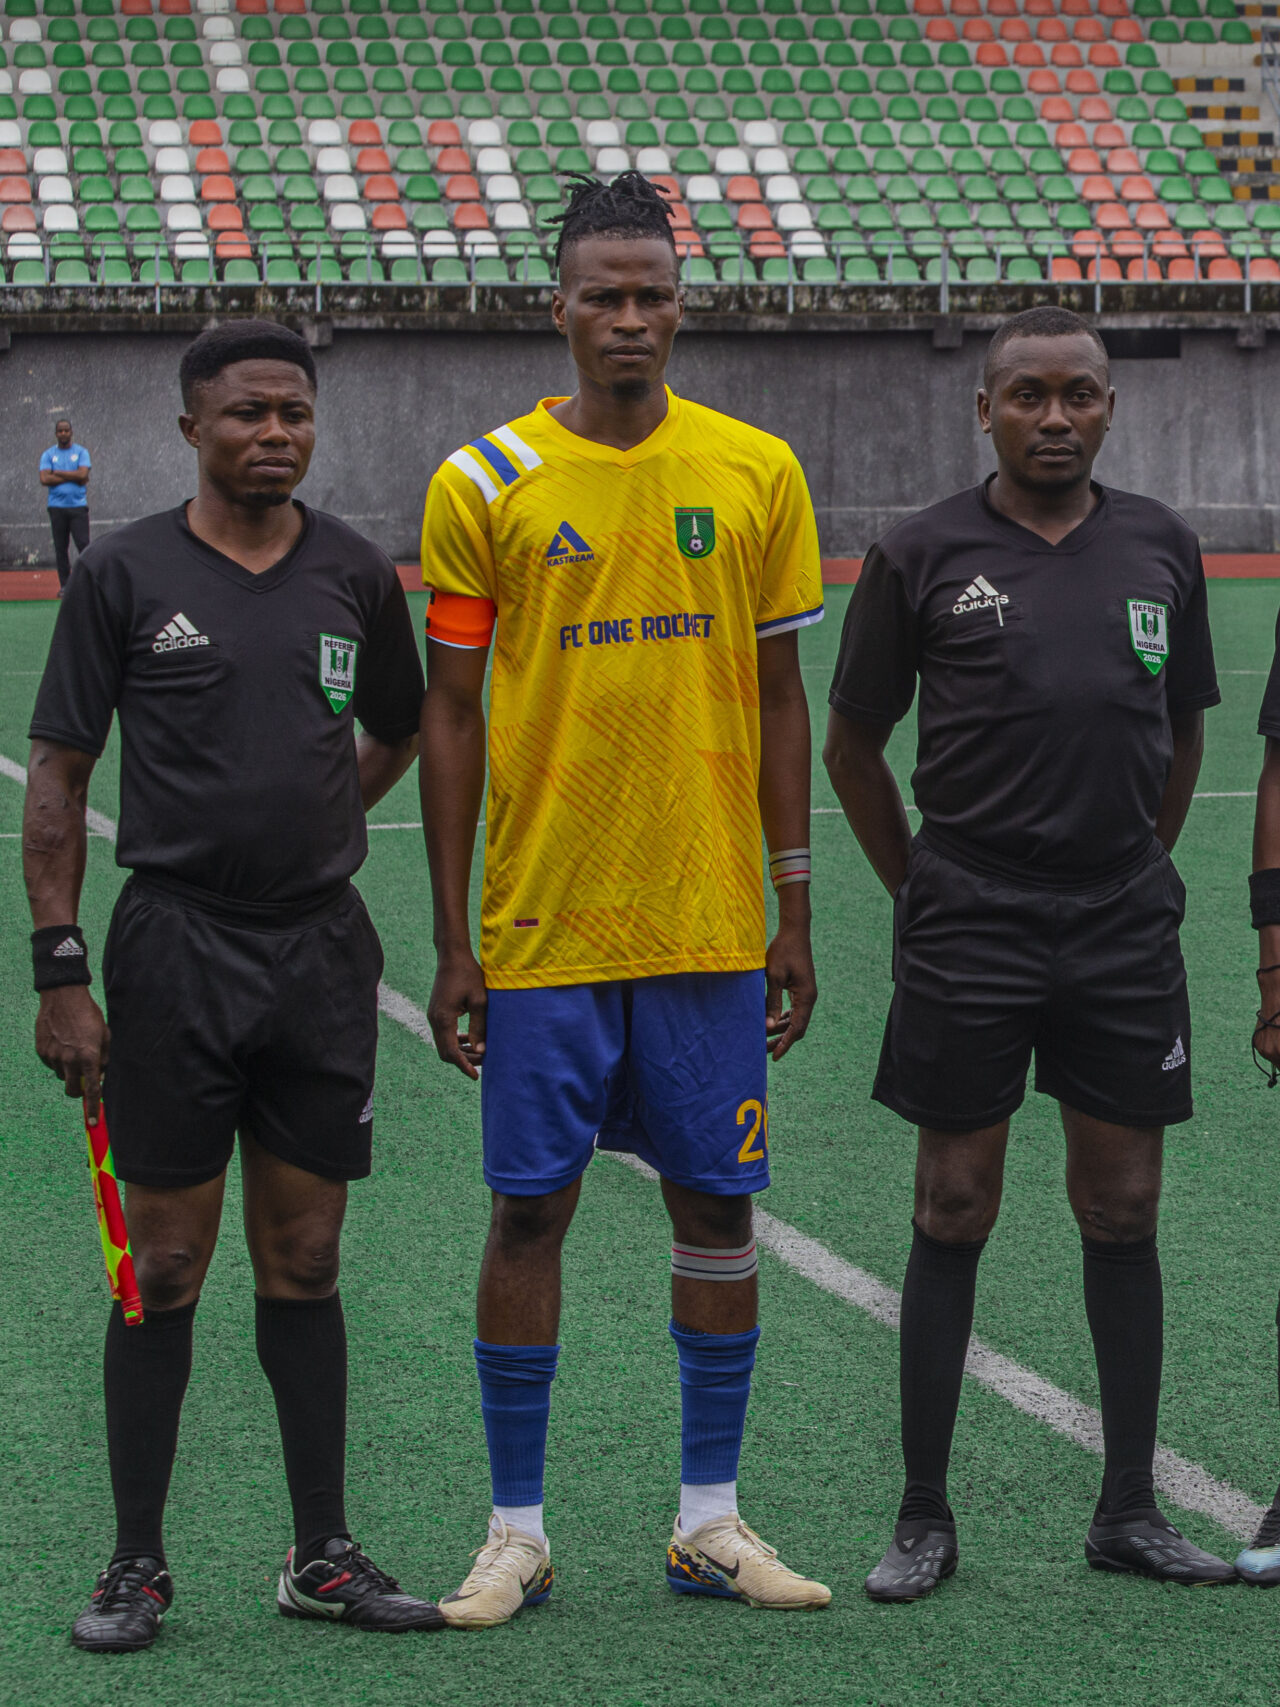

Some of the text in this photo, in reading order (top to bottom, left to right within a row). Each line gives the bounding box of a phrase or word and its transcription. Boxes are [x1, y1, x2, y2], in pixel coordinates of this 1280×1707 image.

[547, 553, 595, 567] KASTREAM
[1132, 603, 1164, 616] REFEREE
[560, 624, 583, 650] FC
[588, 618, 634, 645] ONE
[152, 635, 210, 653] adidas
[325, 639, 355, 652] REFEREE
[1136, 639, 1165, 652] NIGERIA
[1143, 653, 1162, 664] 2026
[325, 677, 352, 689] NIGERIA
[330, 690, 347, 701] 2026
